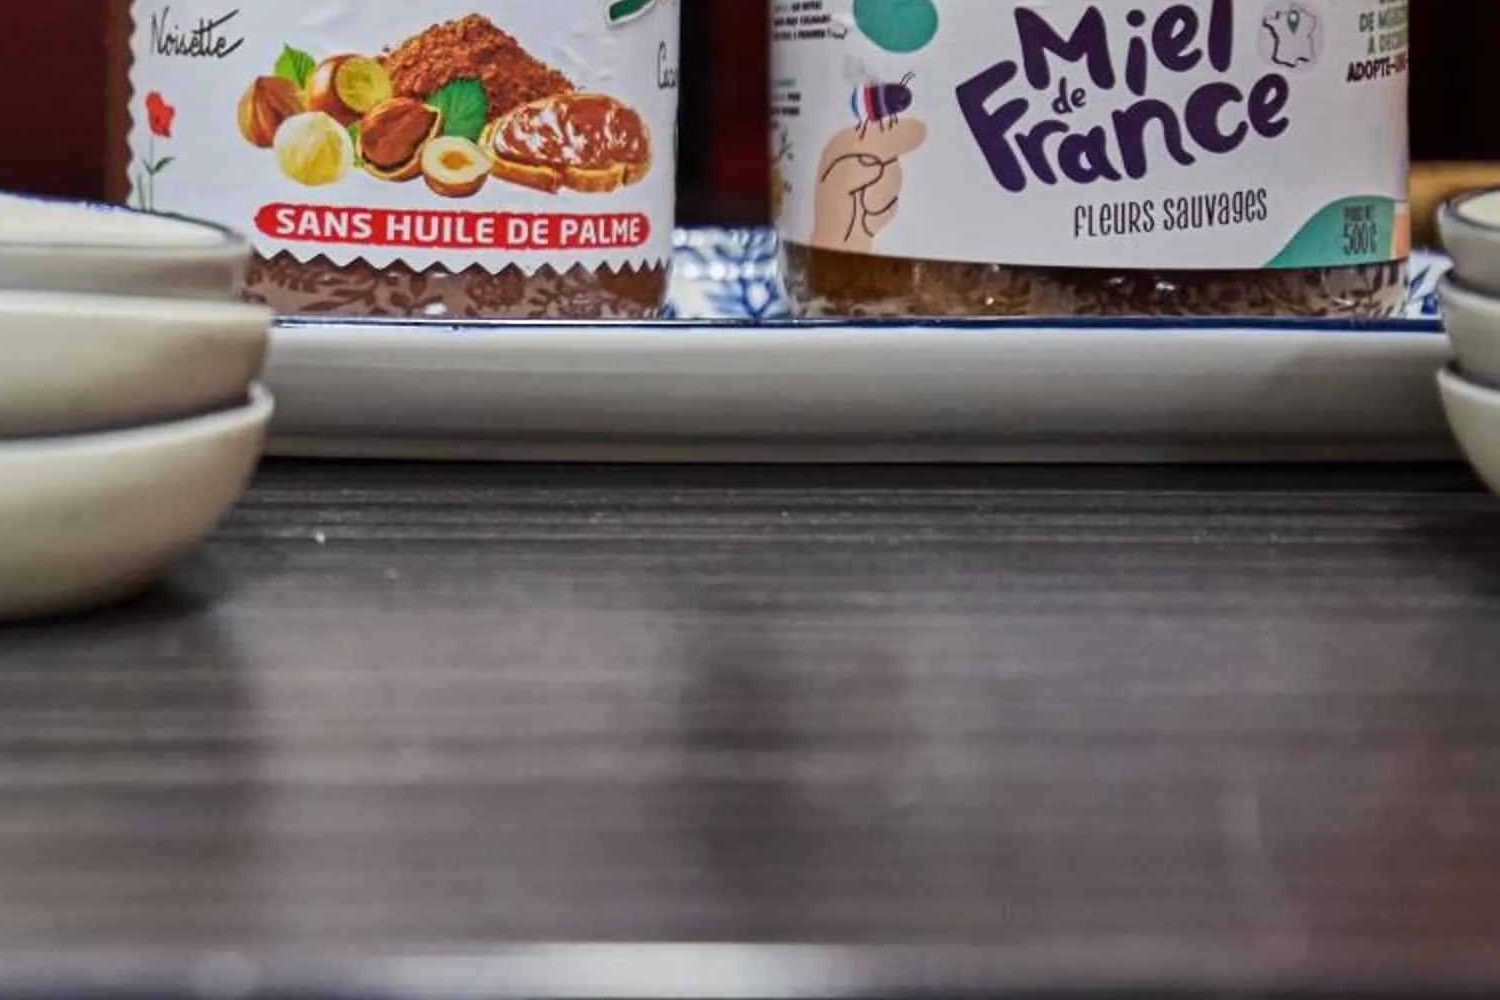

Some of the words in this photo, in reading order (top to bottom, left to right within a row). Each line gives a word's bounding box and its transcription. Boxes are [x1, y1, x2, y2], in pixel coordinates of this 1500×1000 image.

[150, 5, 245, 58] Noisette
[1051, 76, 1087, 115] de
[955, 73, 1290, 193] France
[275, 208, 373, 237] SANS
[386, 214, 495, 243] HUILE
[507, 217, 550, 245] DE
[559, 216, 642, 245] PALME
